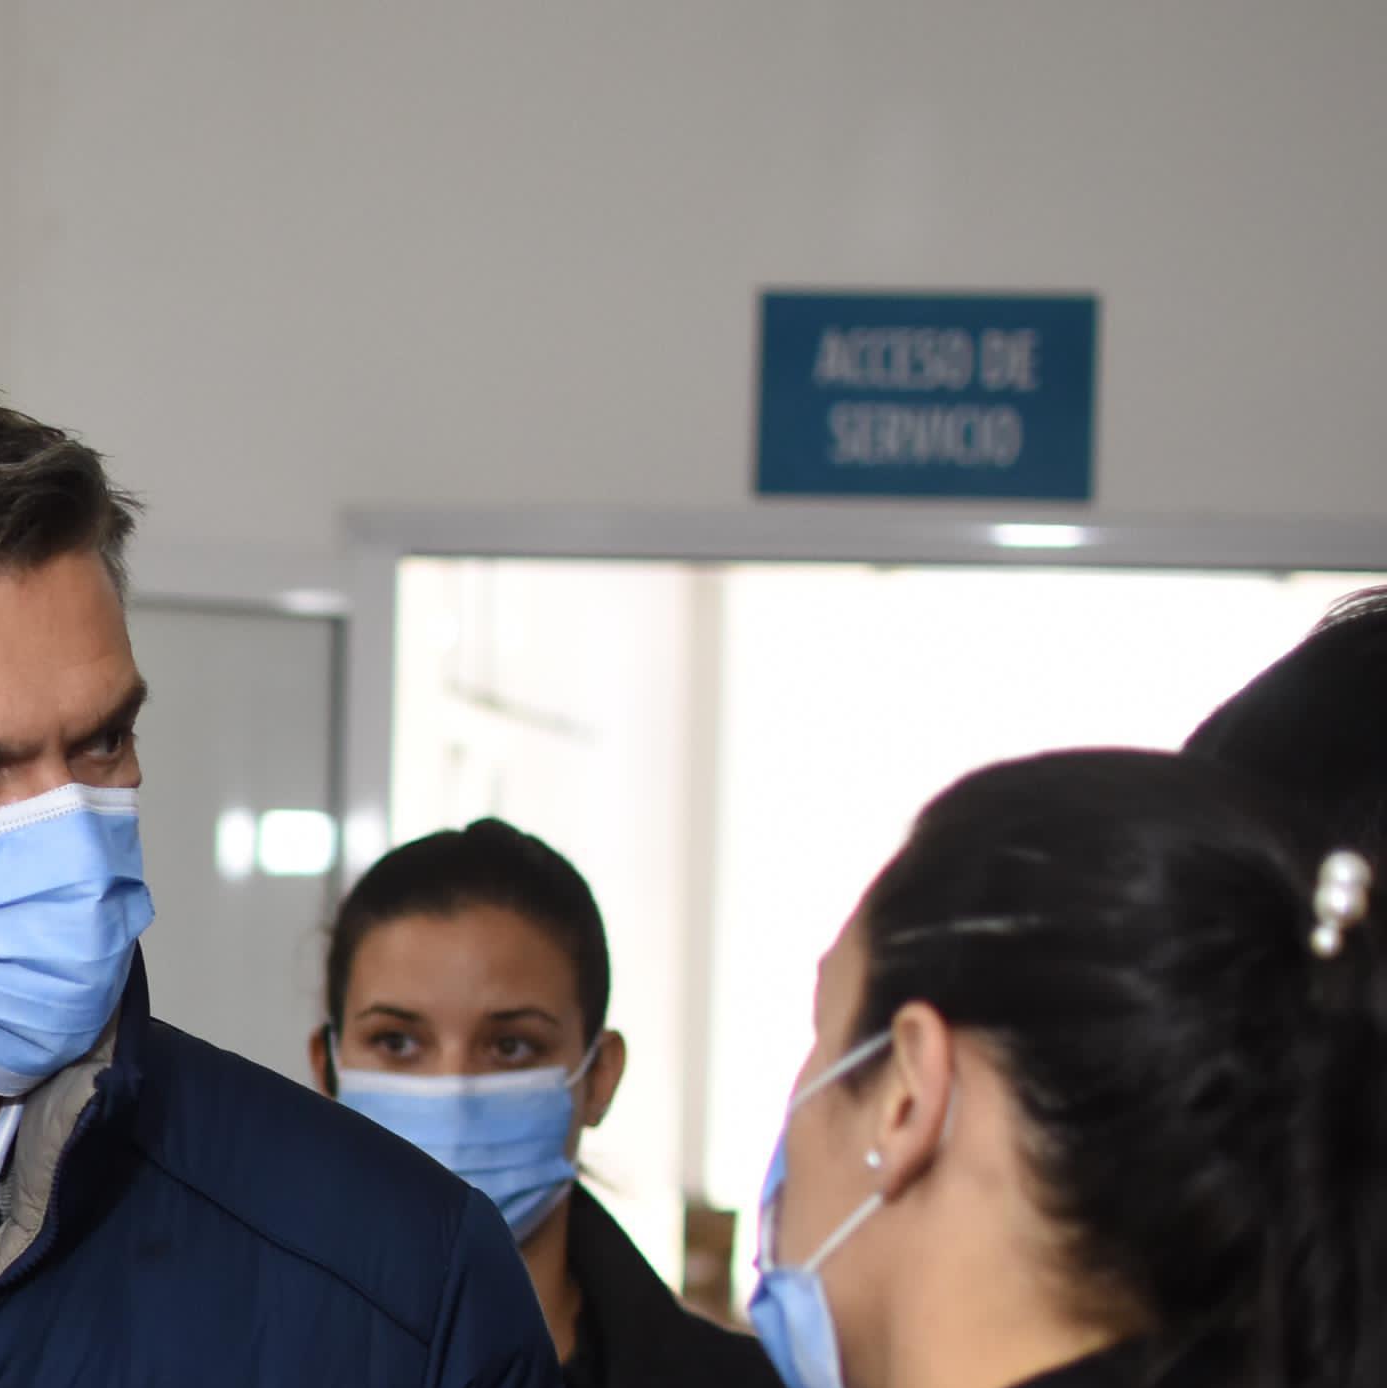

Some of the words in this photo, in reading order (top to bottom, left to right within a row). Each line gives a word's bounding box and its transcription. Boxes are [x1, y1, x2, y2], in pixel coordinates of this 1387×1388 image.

[815, 326, 974, 391] ACCESO
[981, 327, 1040, 392] DE
[829, 402, 1023, 468] SERVICIO
